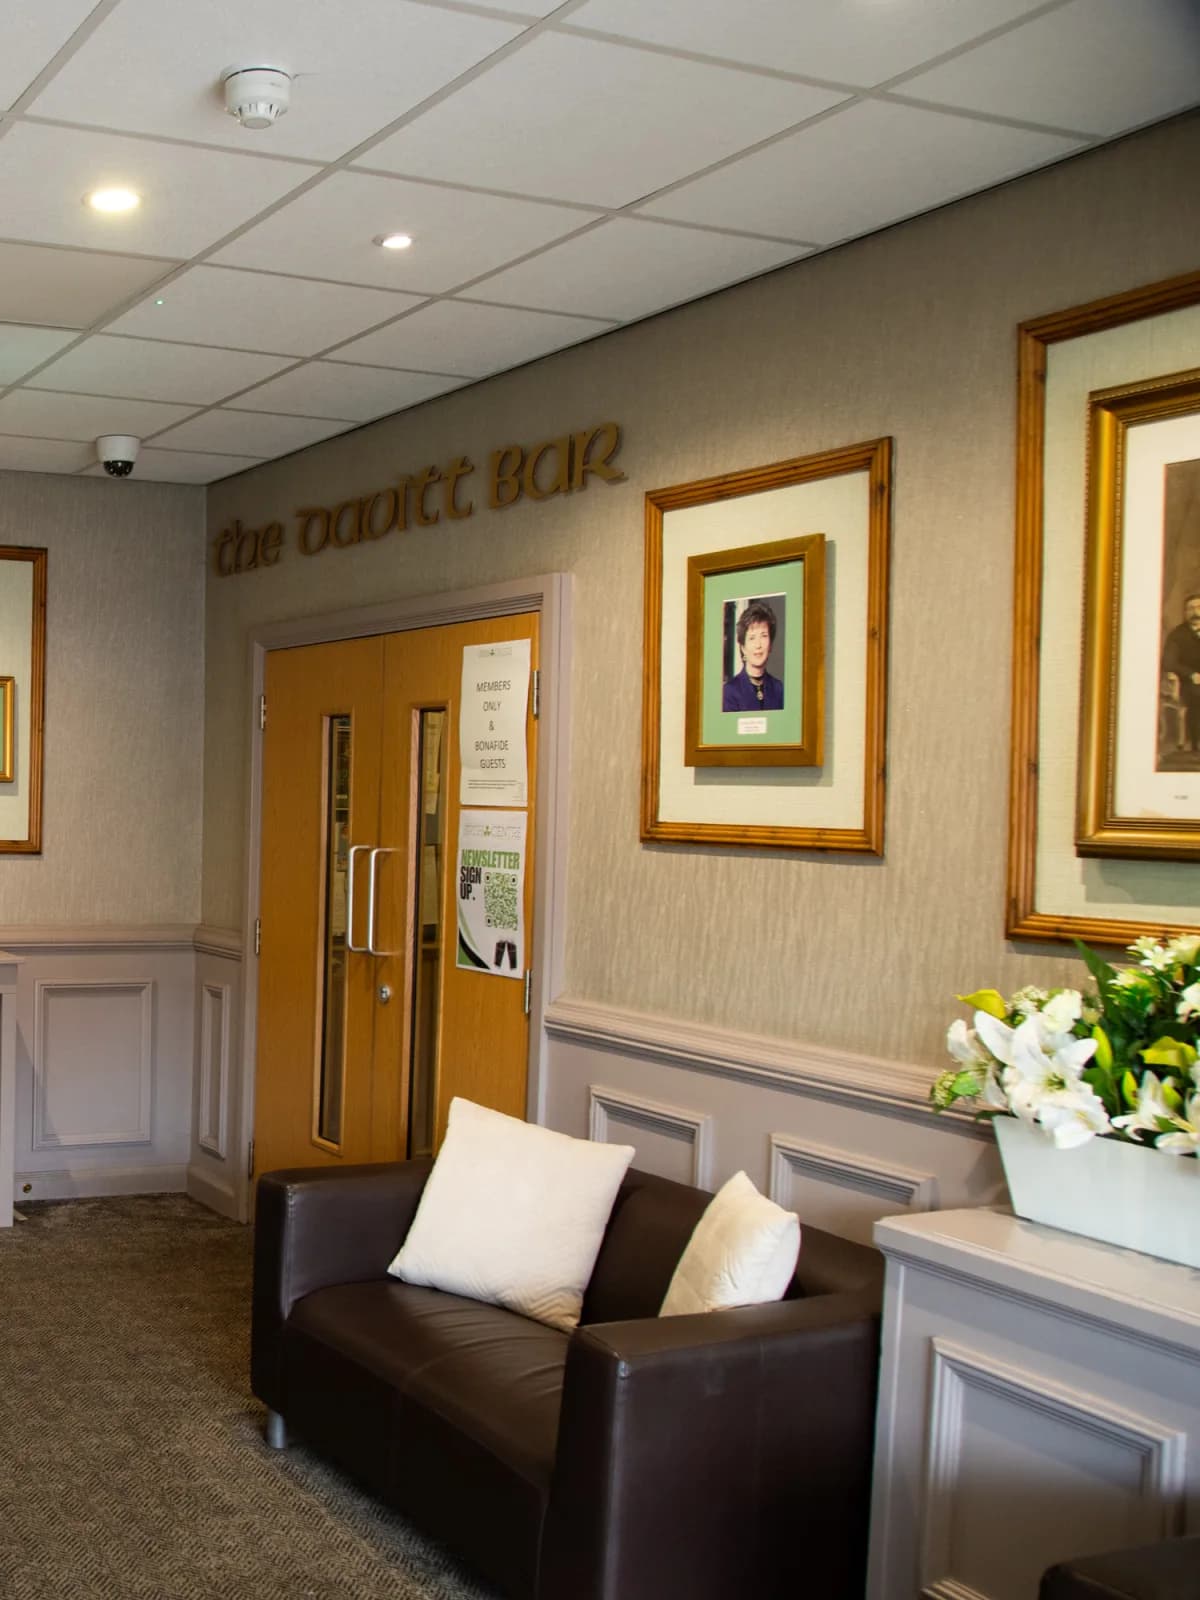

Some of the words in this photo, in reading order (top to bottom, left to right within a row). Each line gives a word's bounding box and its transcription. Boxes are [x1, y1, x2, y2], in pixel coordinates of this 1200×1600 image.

[476, 680, 511, 692] MEMBERS
[482, 701, 502, 712] ONLY
[488, 720, 495, 731] &
[474, 740, 509, 752] BONAFIDE
[479, 758, 506, 769] GUESTS
[461, 849, 520, 870] NEWSLETTER
[460, 866, 482, 884] SIGN
